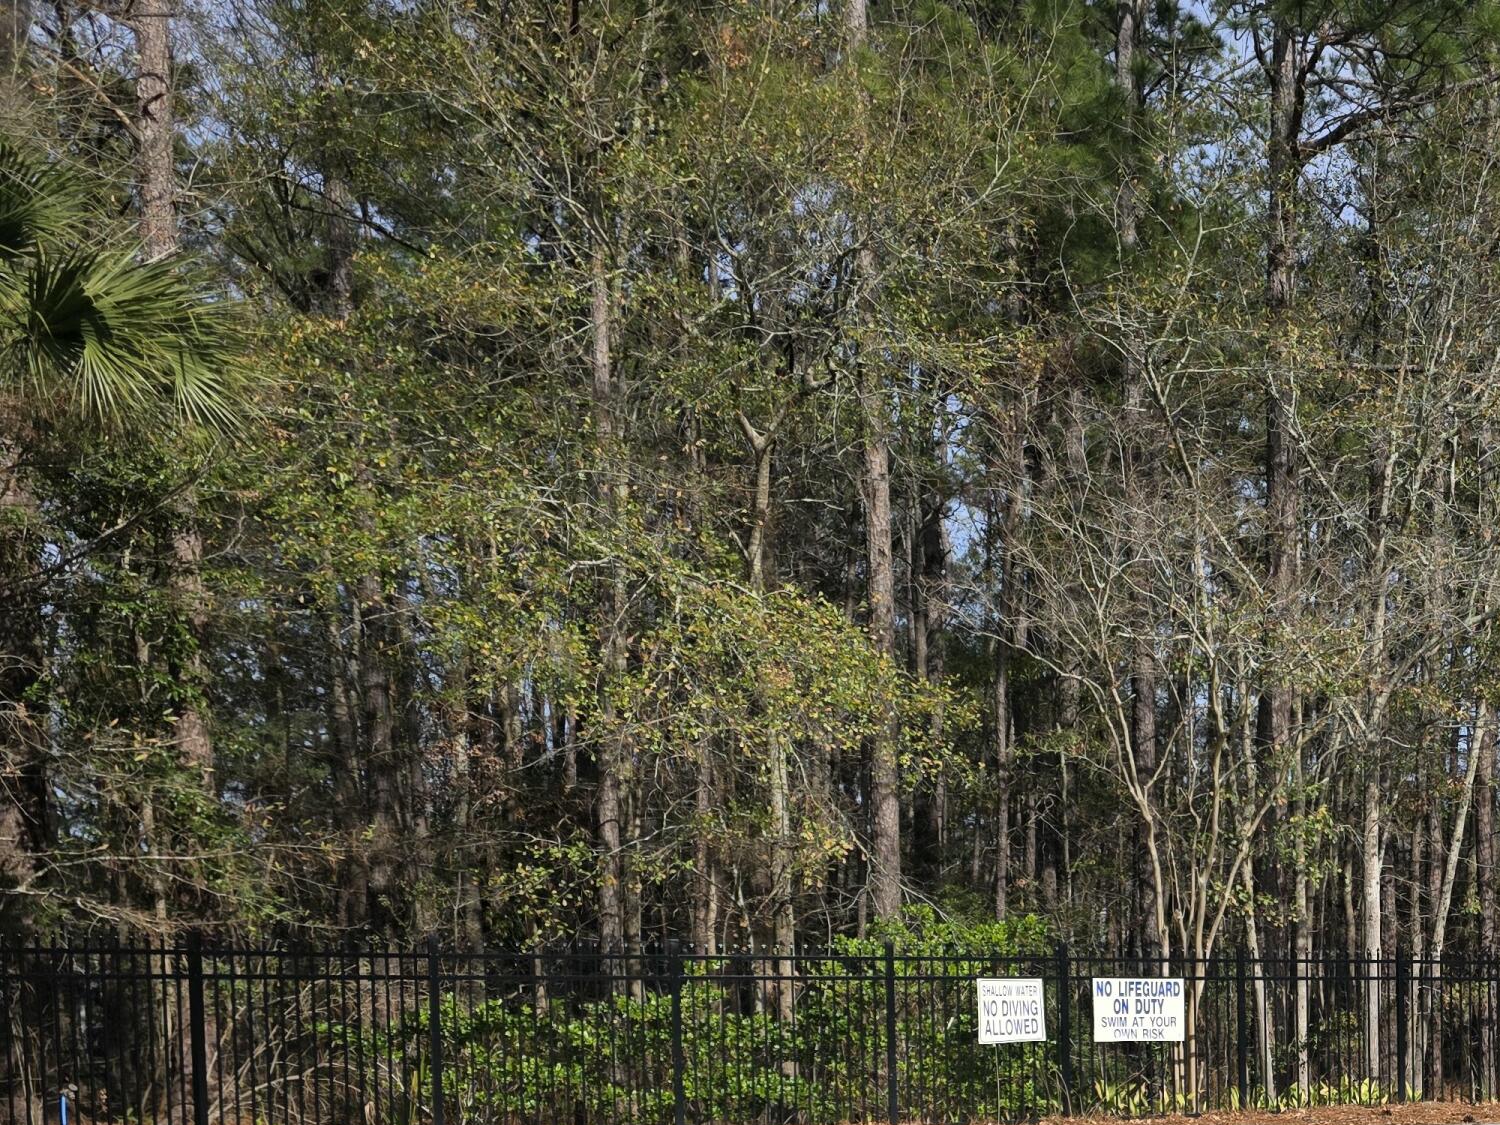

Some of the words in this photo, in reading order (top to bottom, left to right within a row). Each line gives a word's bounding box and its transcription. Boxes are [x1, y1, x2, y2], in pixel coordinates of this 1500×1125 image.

[983, 985, 1012, 997] SHALLOW
[1015, 985, 1038, 997] WATER
[1096, 981, 1112, 997] NO
[1118, 981, 1181, 997] LIFEGUARD
[984, 1000, 998, 1016] NO
[1002, 1000, 1039, 1016] DIVING
[1113, 998, 1129, 1014] ON
[1135, 998, 1164, 1014] DUTY
[985, 1018, 1039, 1036] ALLOWED
[1101, 1016, 1127, 1028] SWIM
[1132, 1016, 1145, 1028] AT
[1149, 1016, 1177, 1028] YOUR
[1114, 1028, 1138, 1039] OWN
[1142, 1028, 1165, 1039] RISK
